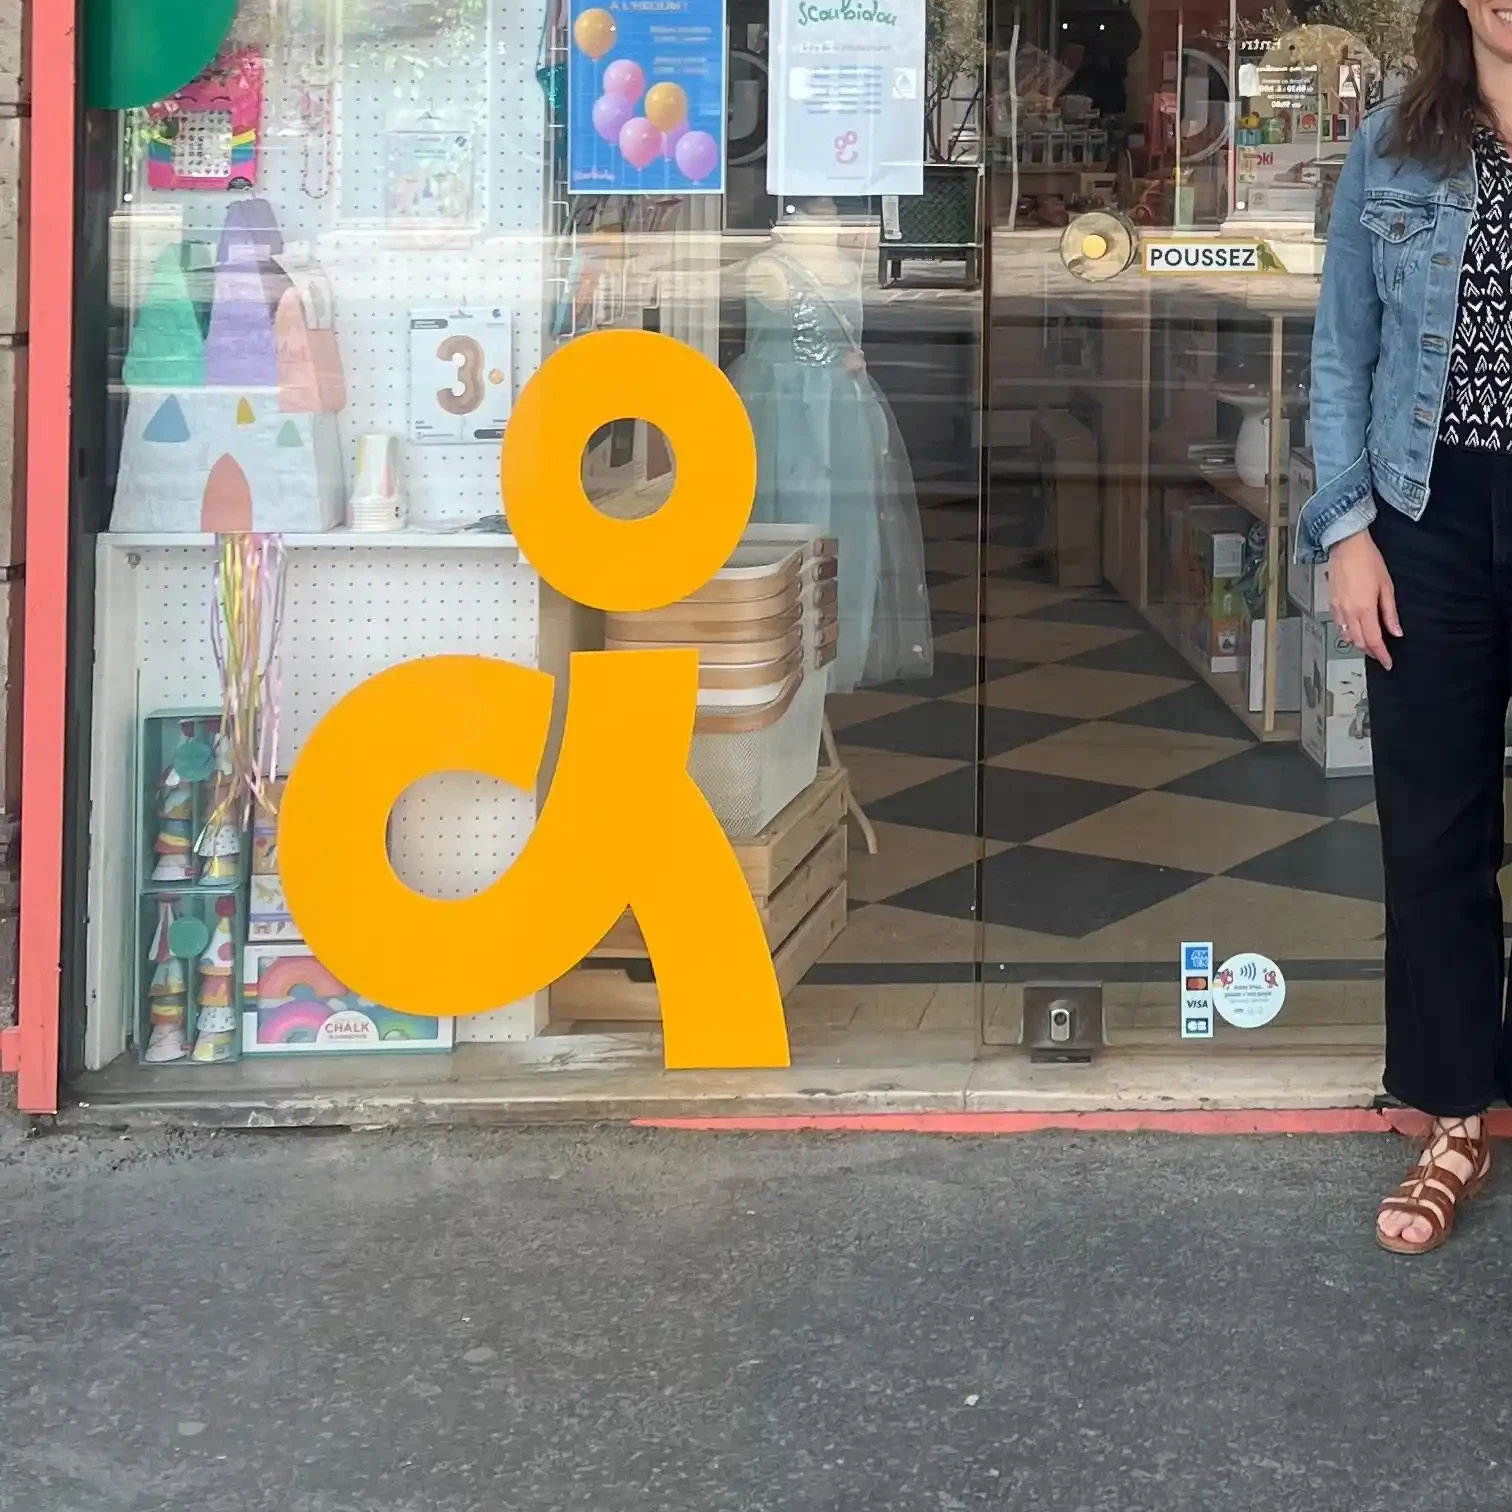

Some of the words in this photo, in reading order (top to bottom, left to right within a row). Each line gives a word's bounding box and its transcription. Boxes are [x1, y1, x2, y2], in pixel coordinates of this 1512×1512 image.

[1150, 248, 1256, 267] POUSSEZ
[436, 334, 485, 416] 3
[1187, 999, 1209, 1009] VISA
[325, 1022, 370, 1033] CHALK
